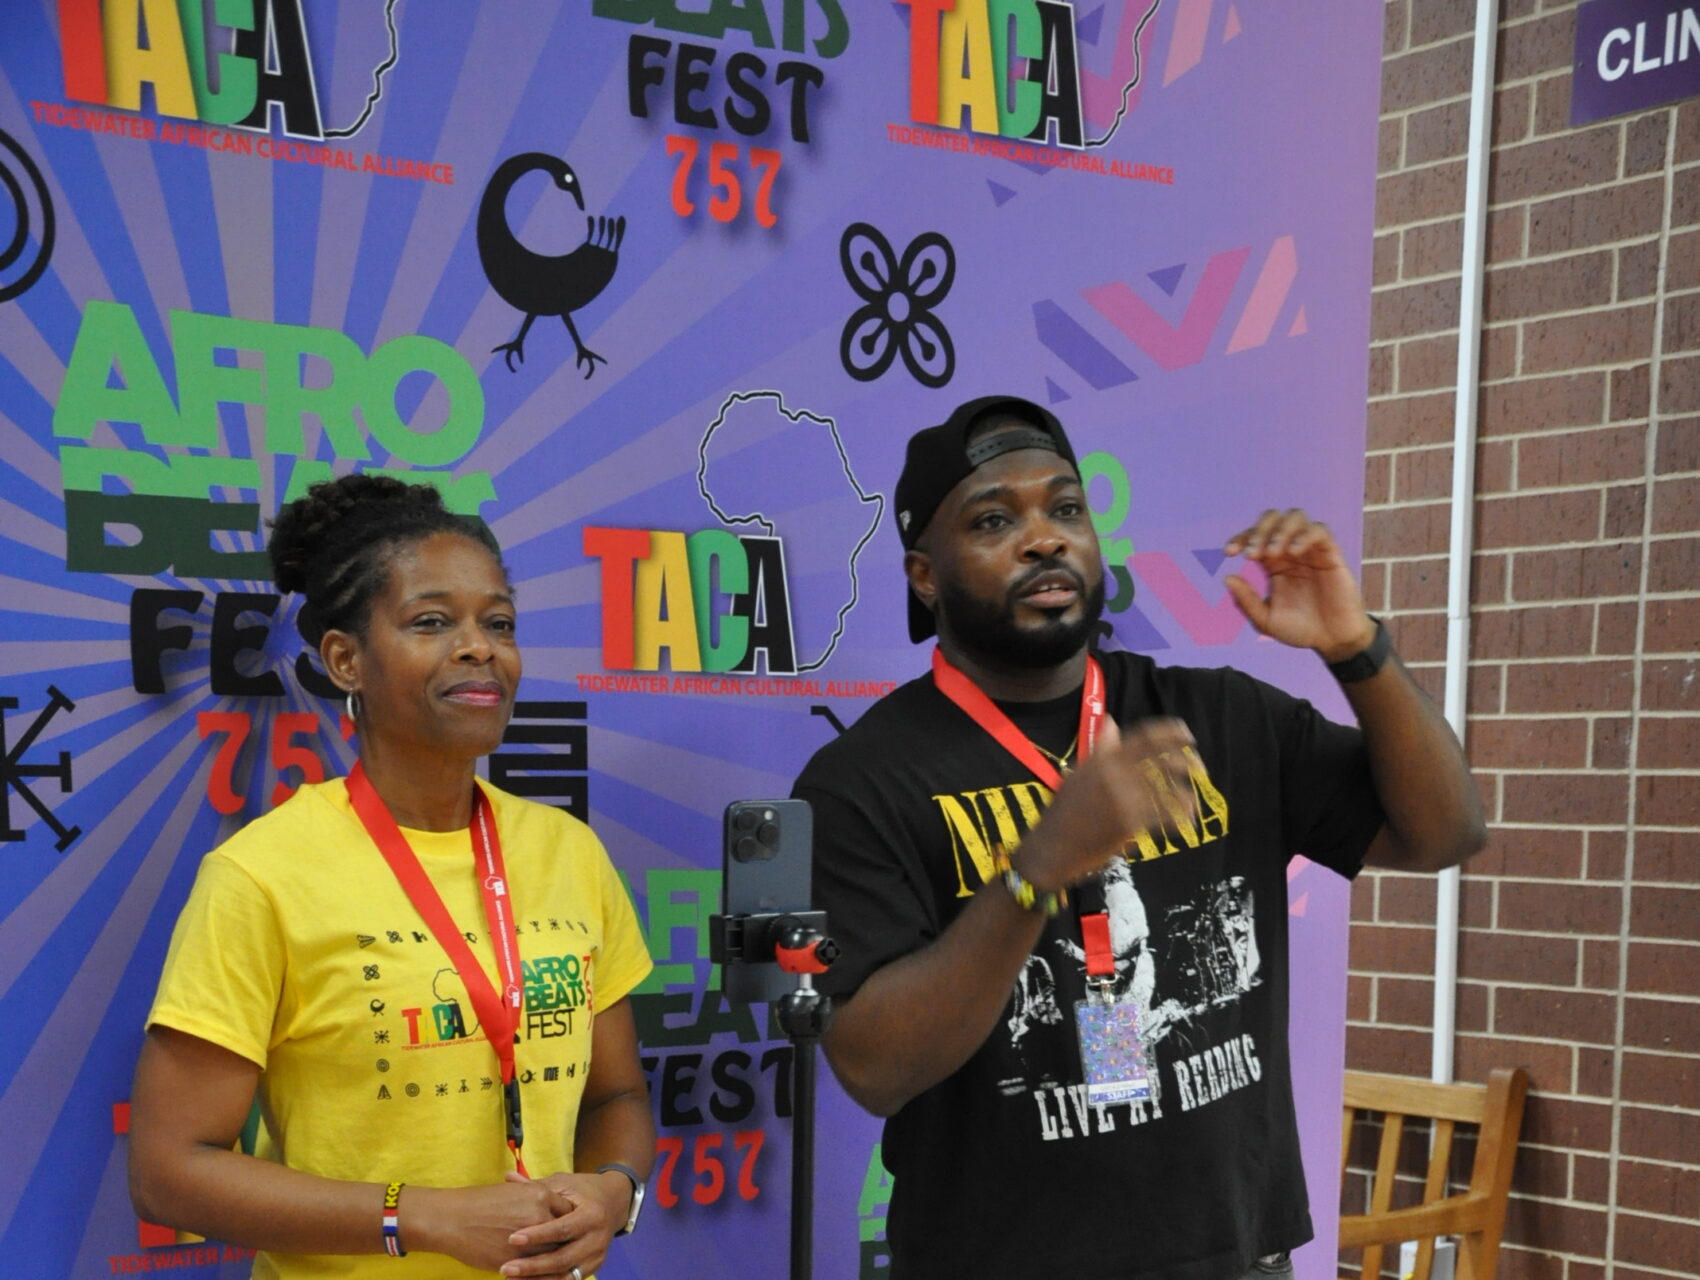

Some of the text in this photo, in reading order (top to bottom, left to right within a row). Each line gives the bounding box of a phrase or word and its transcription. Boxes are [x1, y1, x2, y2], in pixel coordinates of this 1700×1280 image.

[57, 0, 325, 141] TACA
[627, 34, 824, 143] FEST
[909, 0, 1085, 150] TACA
[30, 101, 455, 184] TIDEWATER AFRICAN CULTURAL ALLIANCE
[666, 135, 782, 228] 757
[887, 124, 1174, 185] TIDEWATER AFRICAN CULTURAL ALLIANCE
[53, 300, 485, 467] AFRO
[583, 526, 798, 676] TACA
[576, 673, 670, 694] TIDEWATER
[672, 675, 742, 695] AFRICAN
[744, 678, 823, 697] CULTURAL
[197, 712, 357, 814] 75
[521, 954, 580, 985] AFRO
[524, 979, 586, 1012] BEATS
[527, 1007, 576, 1040] FEST
[1172, 1033, 1262, 1112] READING
[656, 1130, 765, 1209] 757
[108, 1246, 219, 1275] TIDEWATER
